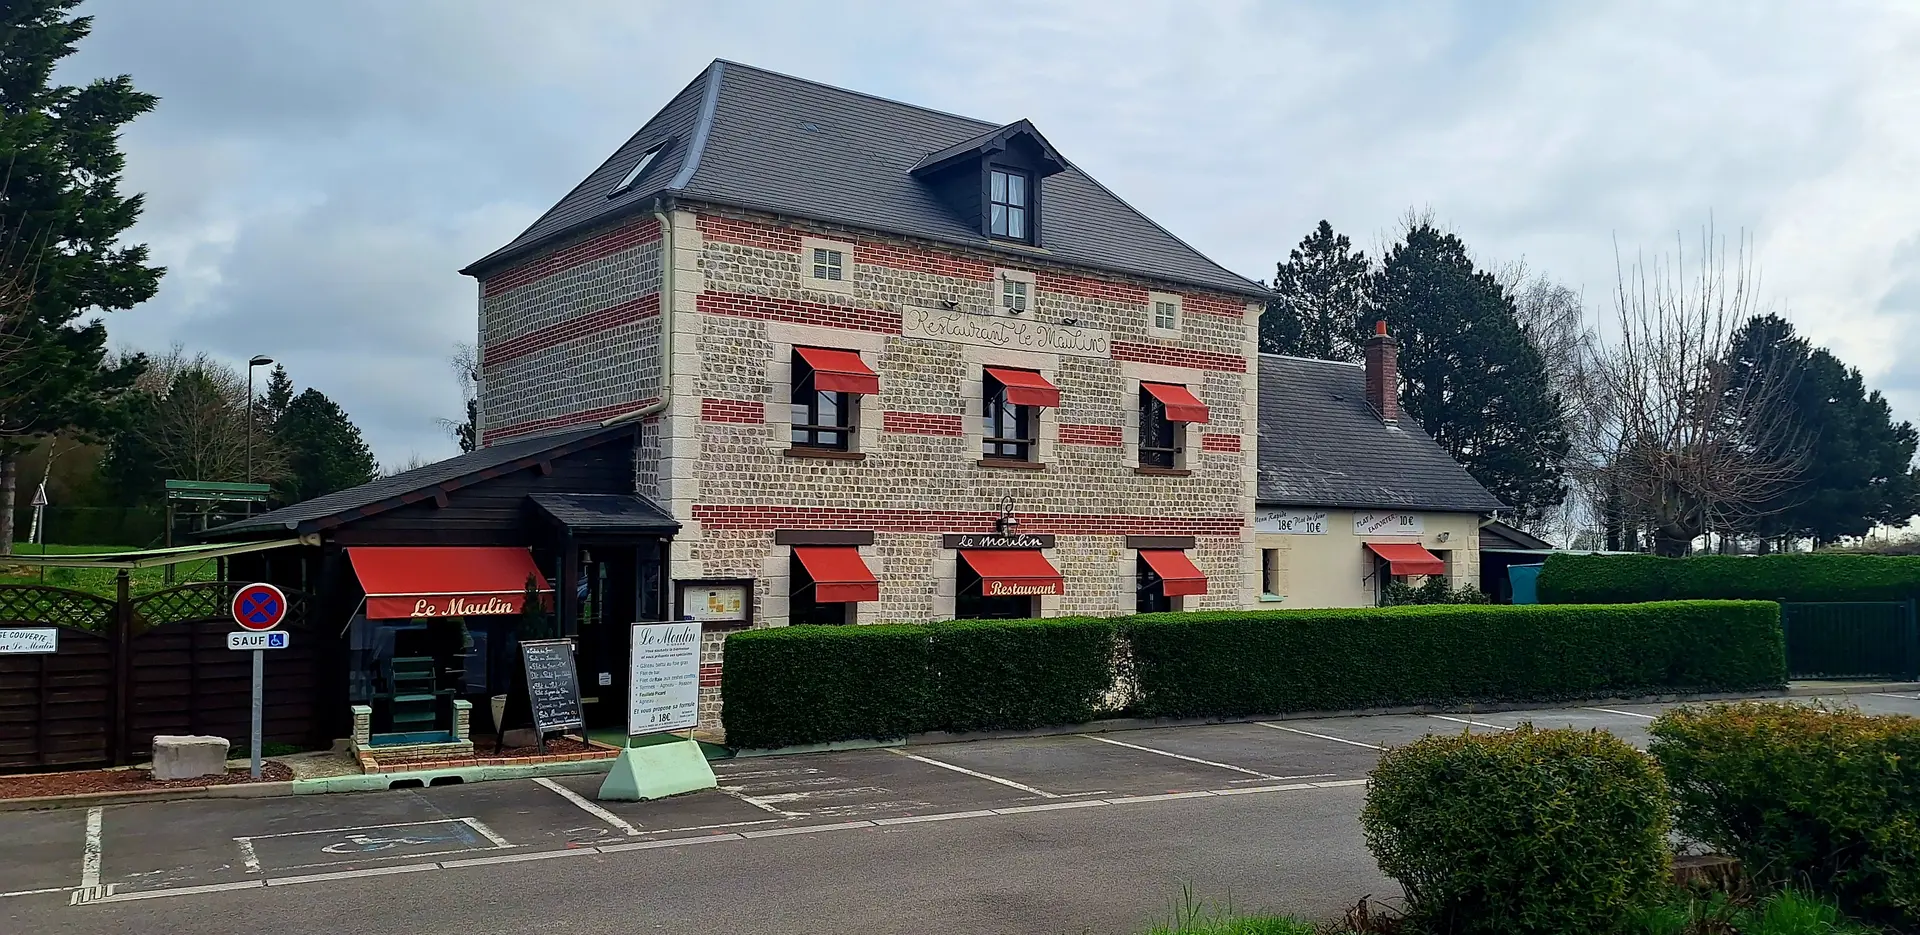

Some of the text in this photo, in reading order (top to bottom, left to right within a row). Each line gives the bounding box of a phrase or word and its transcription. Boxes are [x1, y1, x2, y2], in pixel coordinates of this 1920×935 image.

[906, 309, 1015, 345] Restaurant
[1037, 325, 1106, 353] Moulin
[1278, 519, 1293, 531] 18€
[989, 580, 1057, 596] Restaurant
[410, 596, 514, 617] Le Moulin
[10, 631, 48, 643] COUVERTE
[232, 636, 266, 646] SAUF
[639, 625, 696, 646] Le Moulin
[653, 705, 671, 713] propose
[679, 701, 695, 709] formule
[650, 714, 656, 723] à
[658, 712, 671, 723] 18€
